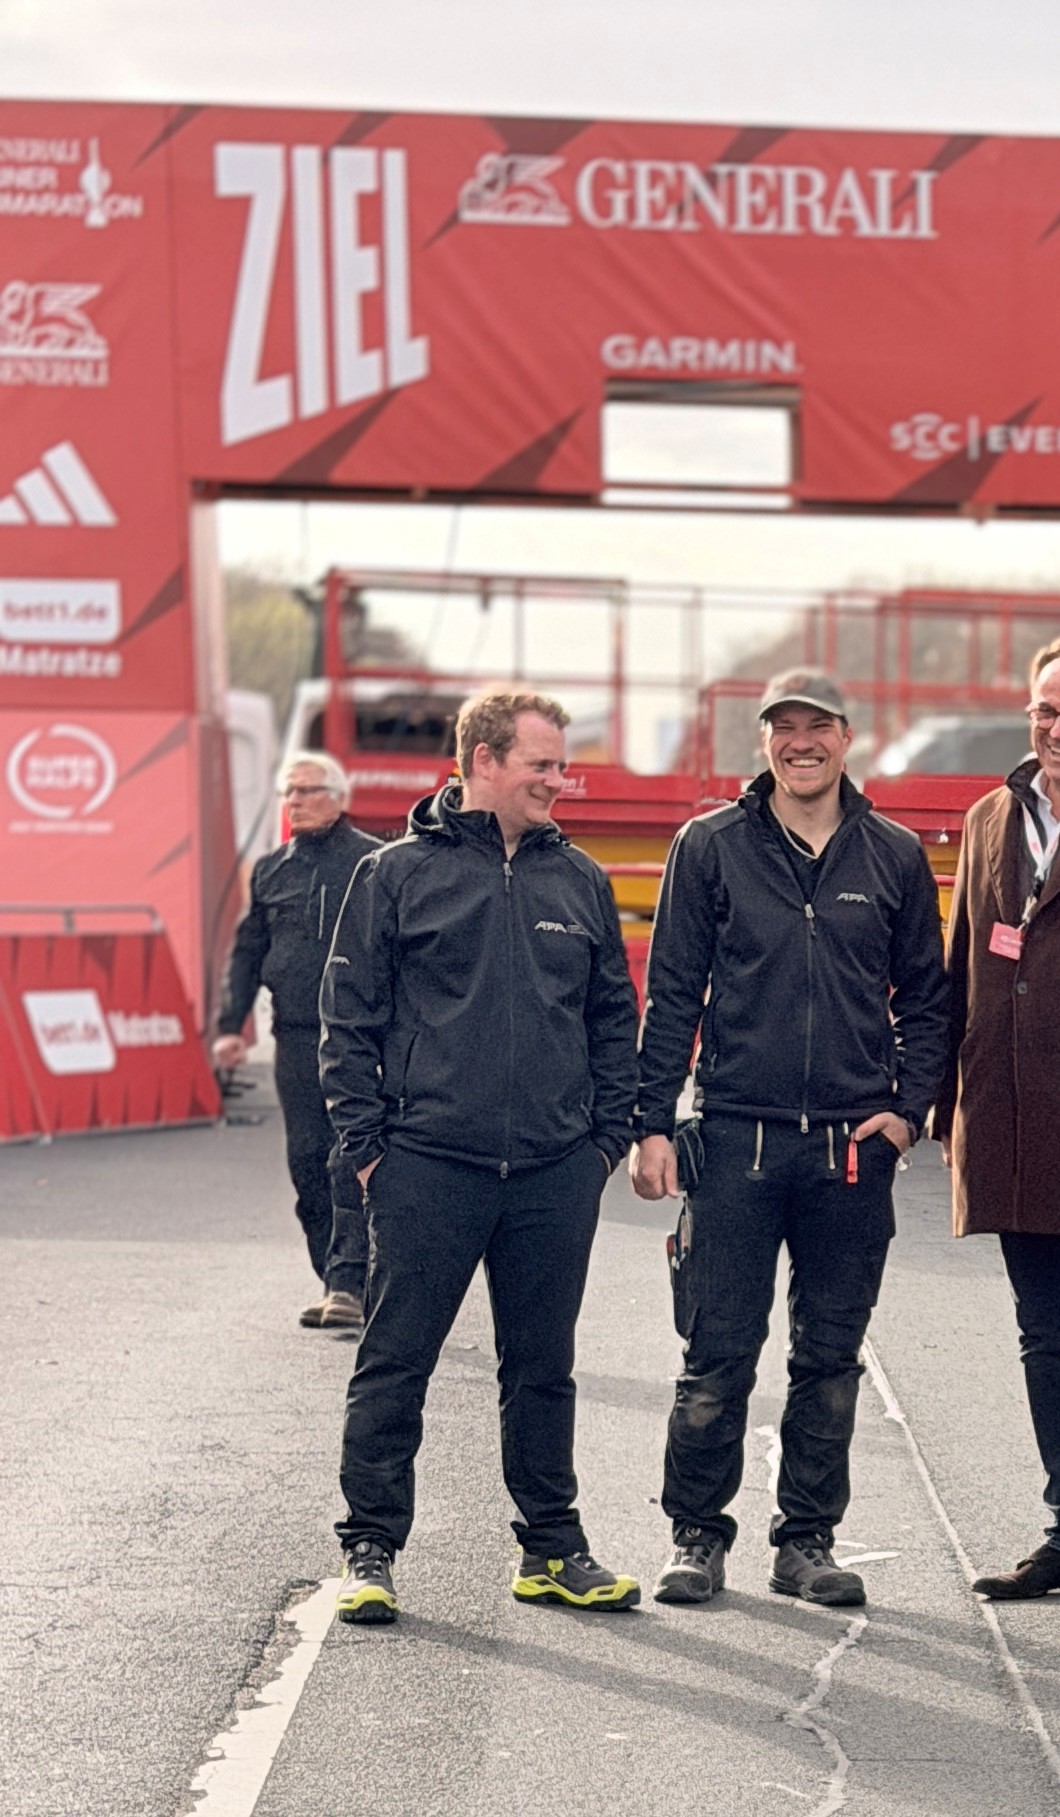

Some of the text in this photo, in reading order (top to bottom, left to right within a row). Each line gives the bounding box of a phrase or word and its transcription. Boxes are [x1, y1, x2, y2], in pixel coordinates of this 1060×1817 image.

[575, 157, 939, 239] GENERALI
[213, 141, 430, 447] ZIEL
[0, 358, 108, 387] ENERALI
[0, 644, 122, 678] Matratze
